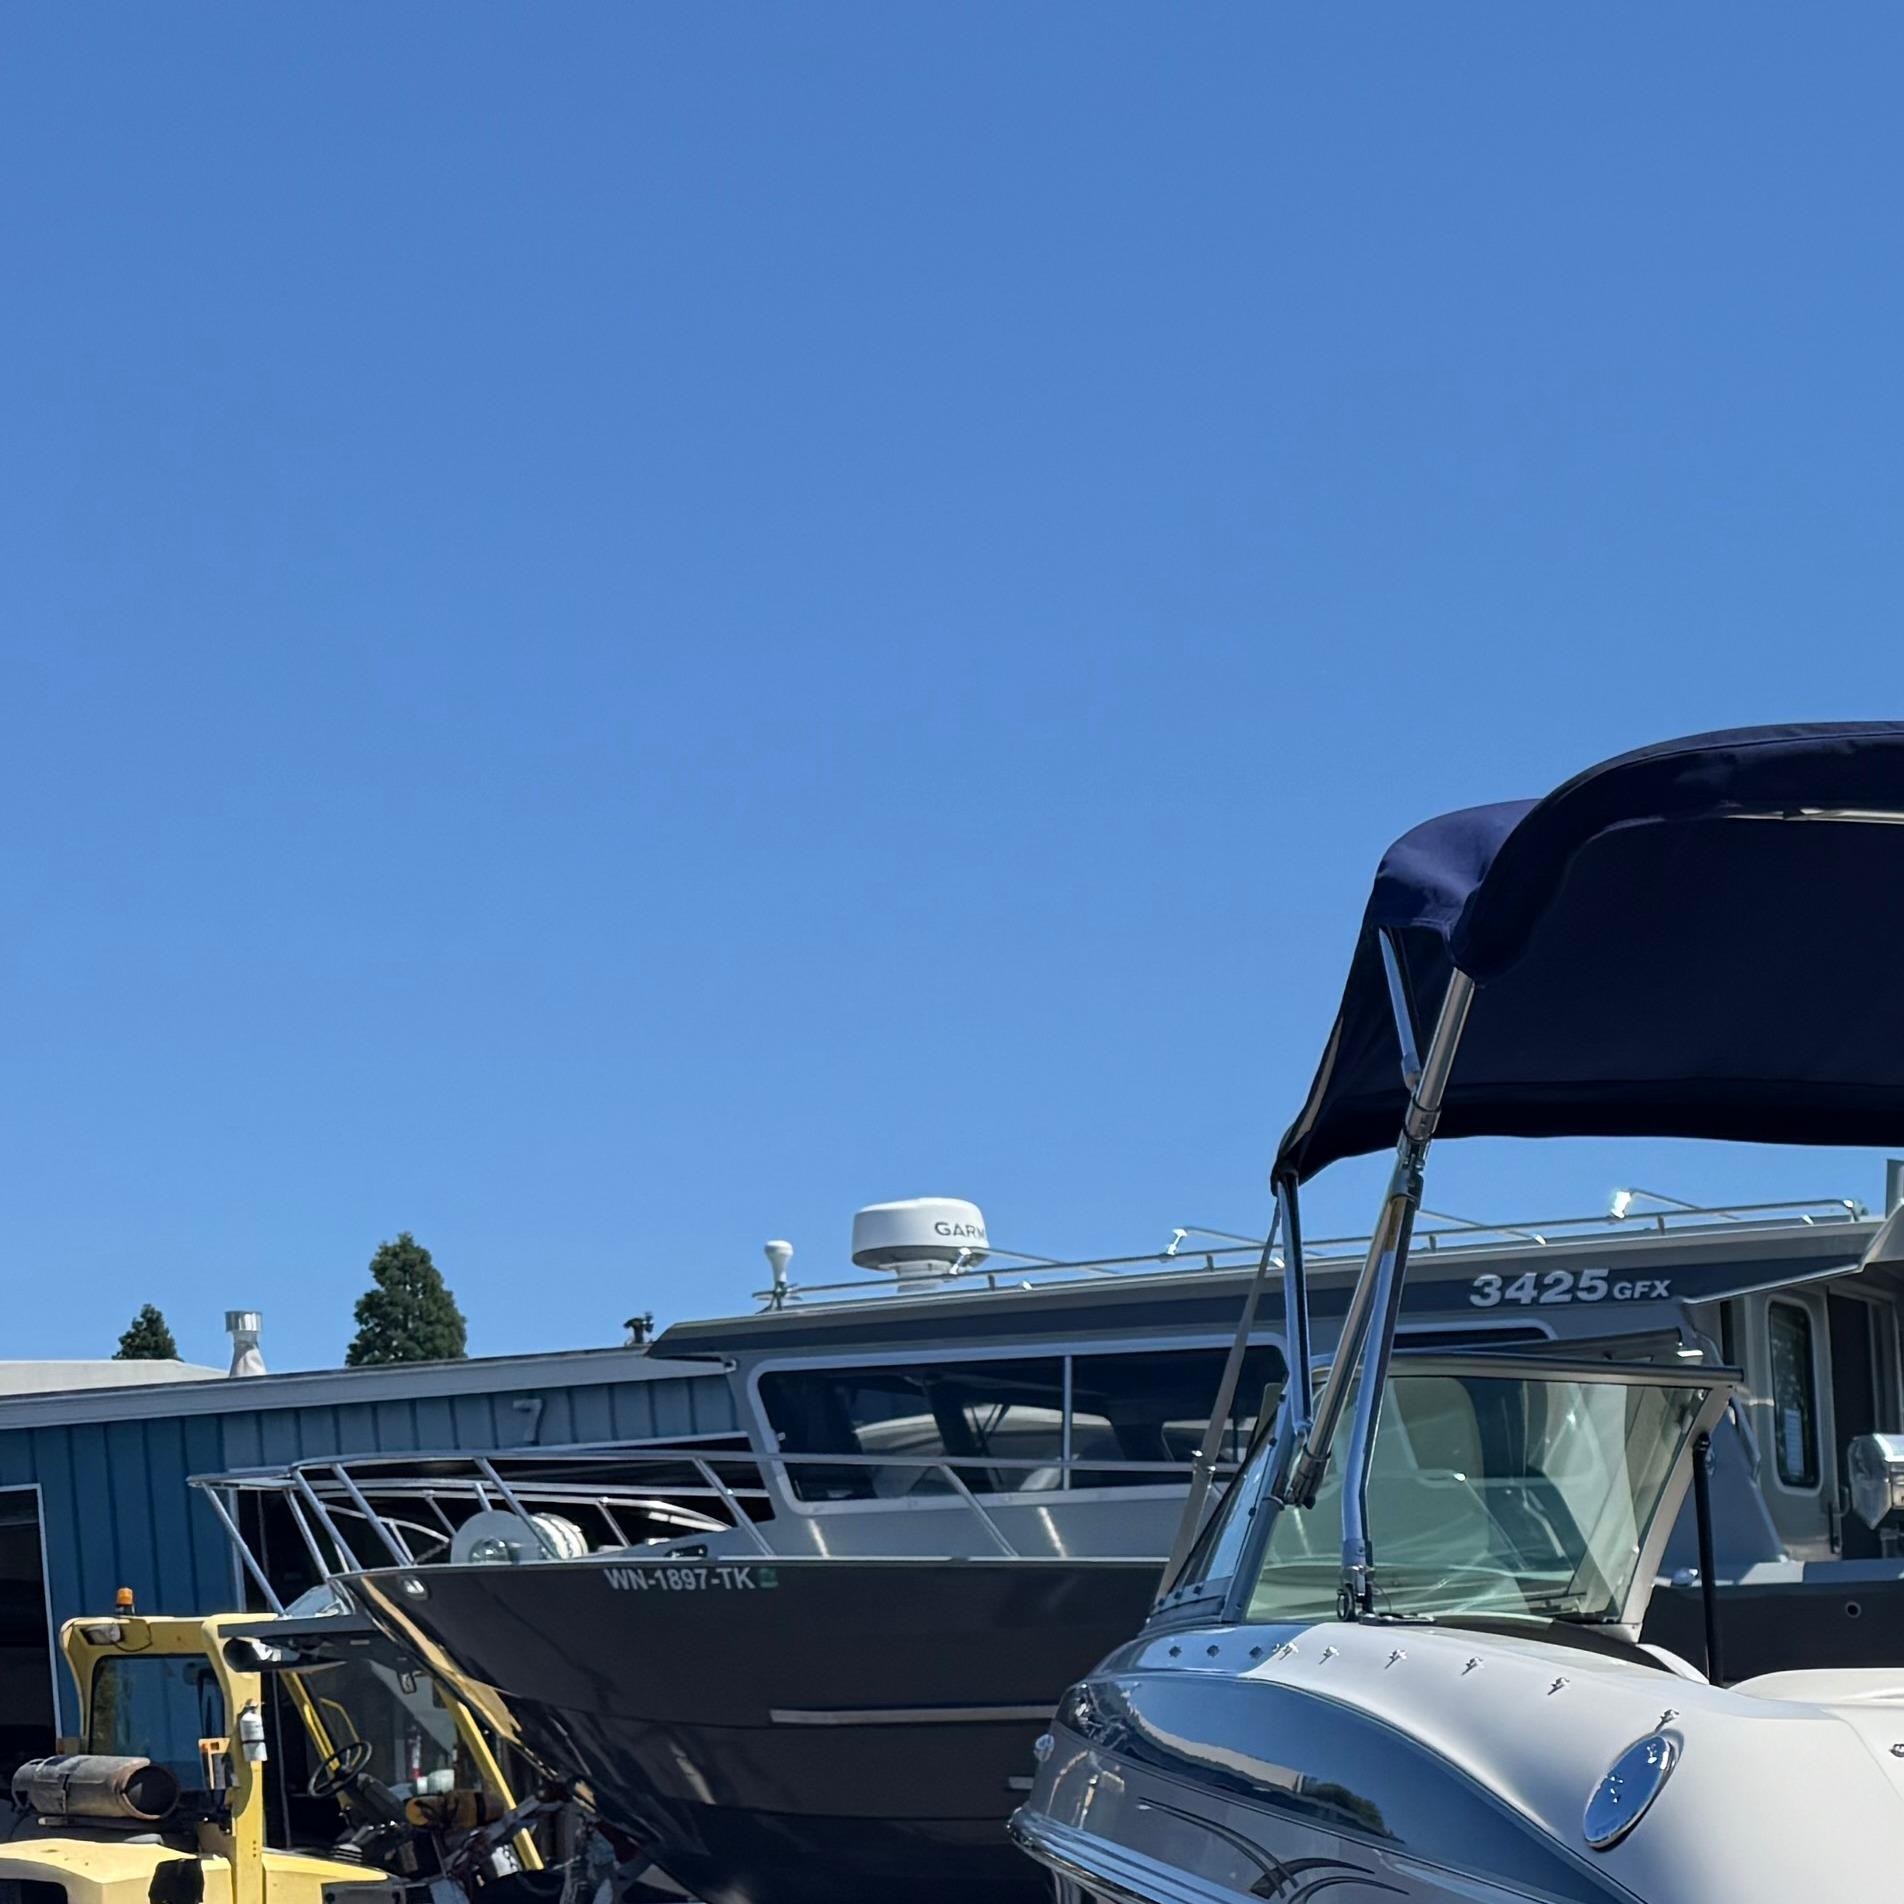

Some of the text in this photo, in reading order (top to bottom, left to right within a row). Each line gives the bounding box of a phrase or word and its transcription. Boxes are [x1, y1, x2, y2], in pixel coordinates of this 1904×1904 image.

[1470, 1269, 1671, 1307] 3425 GFX
[513, 1399, 542, 1441] 7
[604, 1567, 755, 1590] WN-1897-TK
